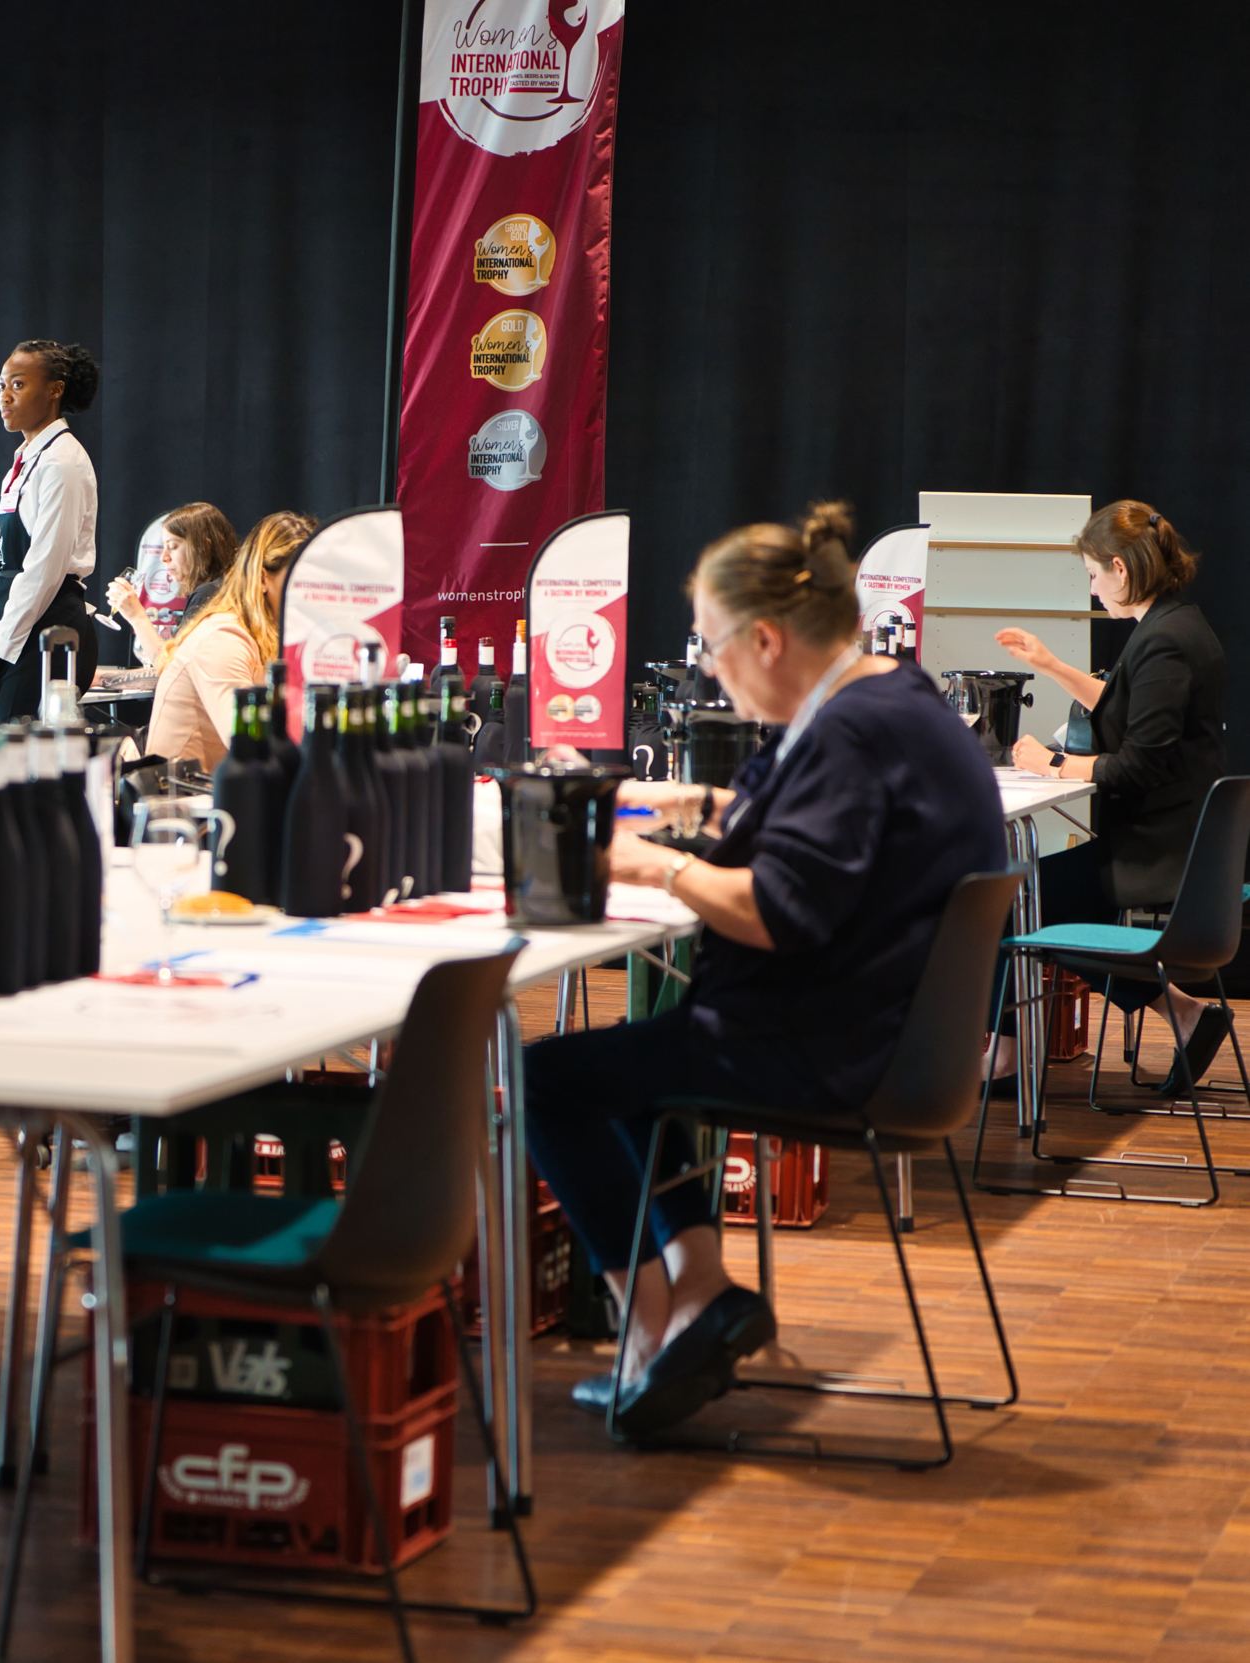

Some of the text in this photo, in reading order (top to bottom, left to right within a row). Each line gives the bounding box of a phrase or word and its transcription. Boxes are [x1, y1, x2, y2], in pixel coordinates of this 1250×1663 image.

[453, 16, 563, 50] Women's
[451, 50, 561, 73] INTERNATIONAL
[450, 76, 510, 97] TROPHY
[504, 223, 527, 232] GRAND
[510, 232, 528, 241] GOLD
[477, 241, 535, 257] Women's
[476, 258, 534, 268] INTERNATIONAL
[476, 270, 509, 280] TROPHY
[501, 320, 523, 332] GOLD
[473, 337, 532, 353] Women's
[473, 353, 530, 364] INTERNATIONAL
[473, 365, 506, 375] TROPHY
[496, 420, 519, 431] SILVER
[470, 437, 525, 453] Women's
[470, 452, 524, 464] INTERNATIONAL
[470, 465, 502, 476] TROPHY
[859, 574, 922, 584] INTERNATIONAL COMPETITION
[171, 1443, 297, 1509] cfp
